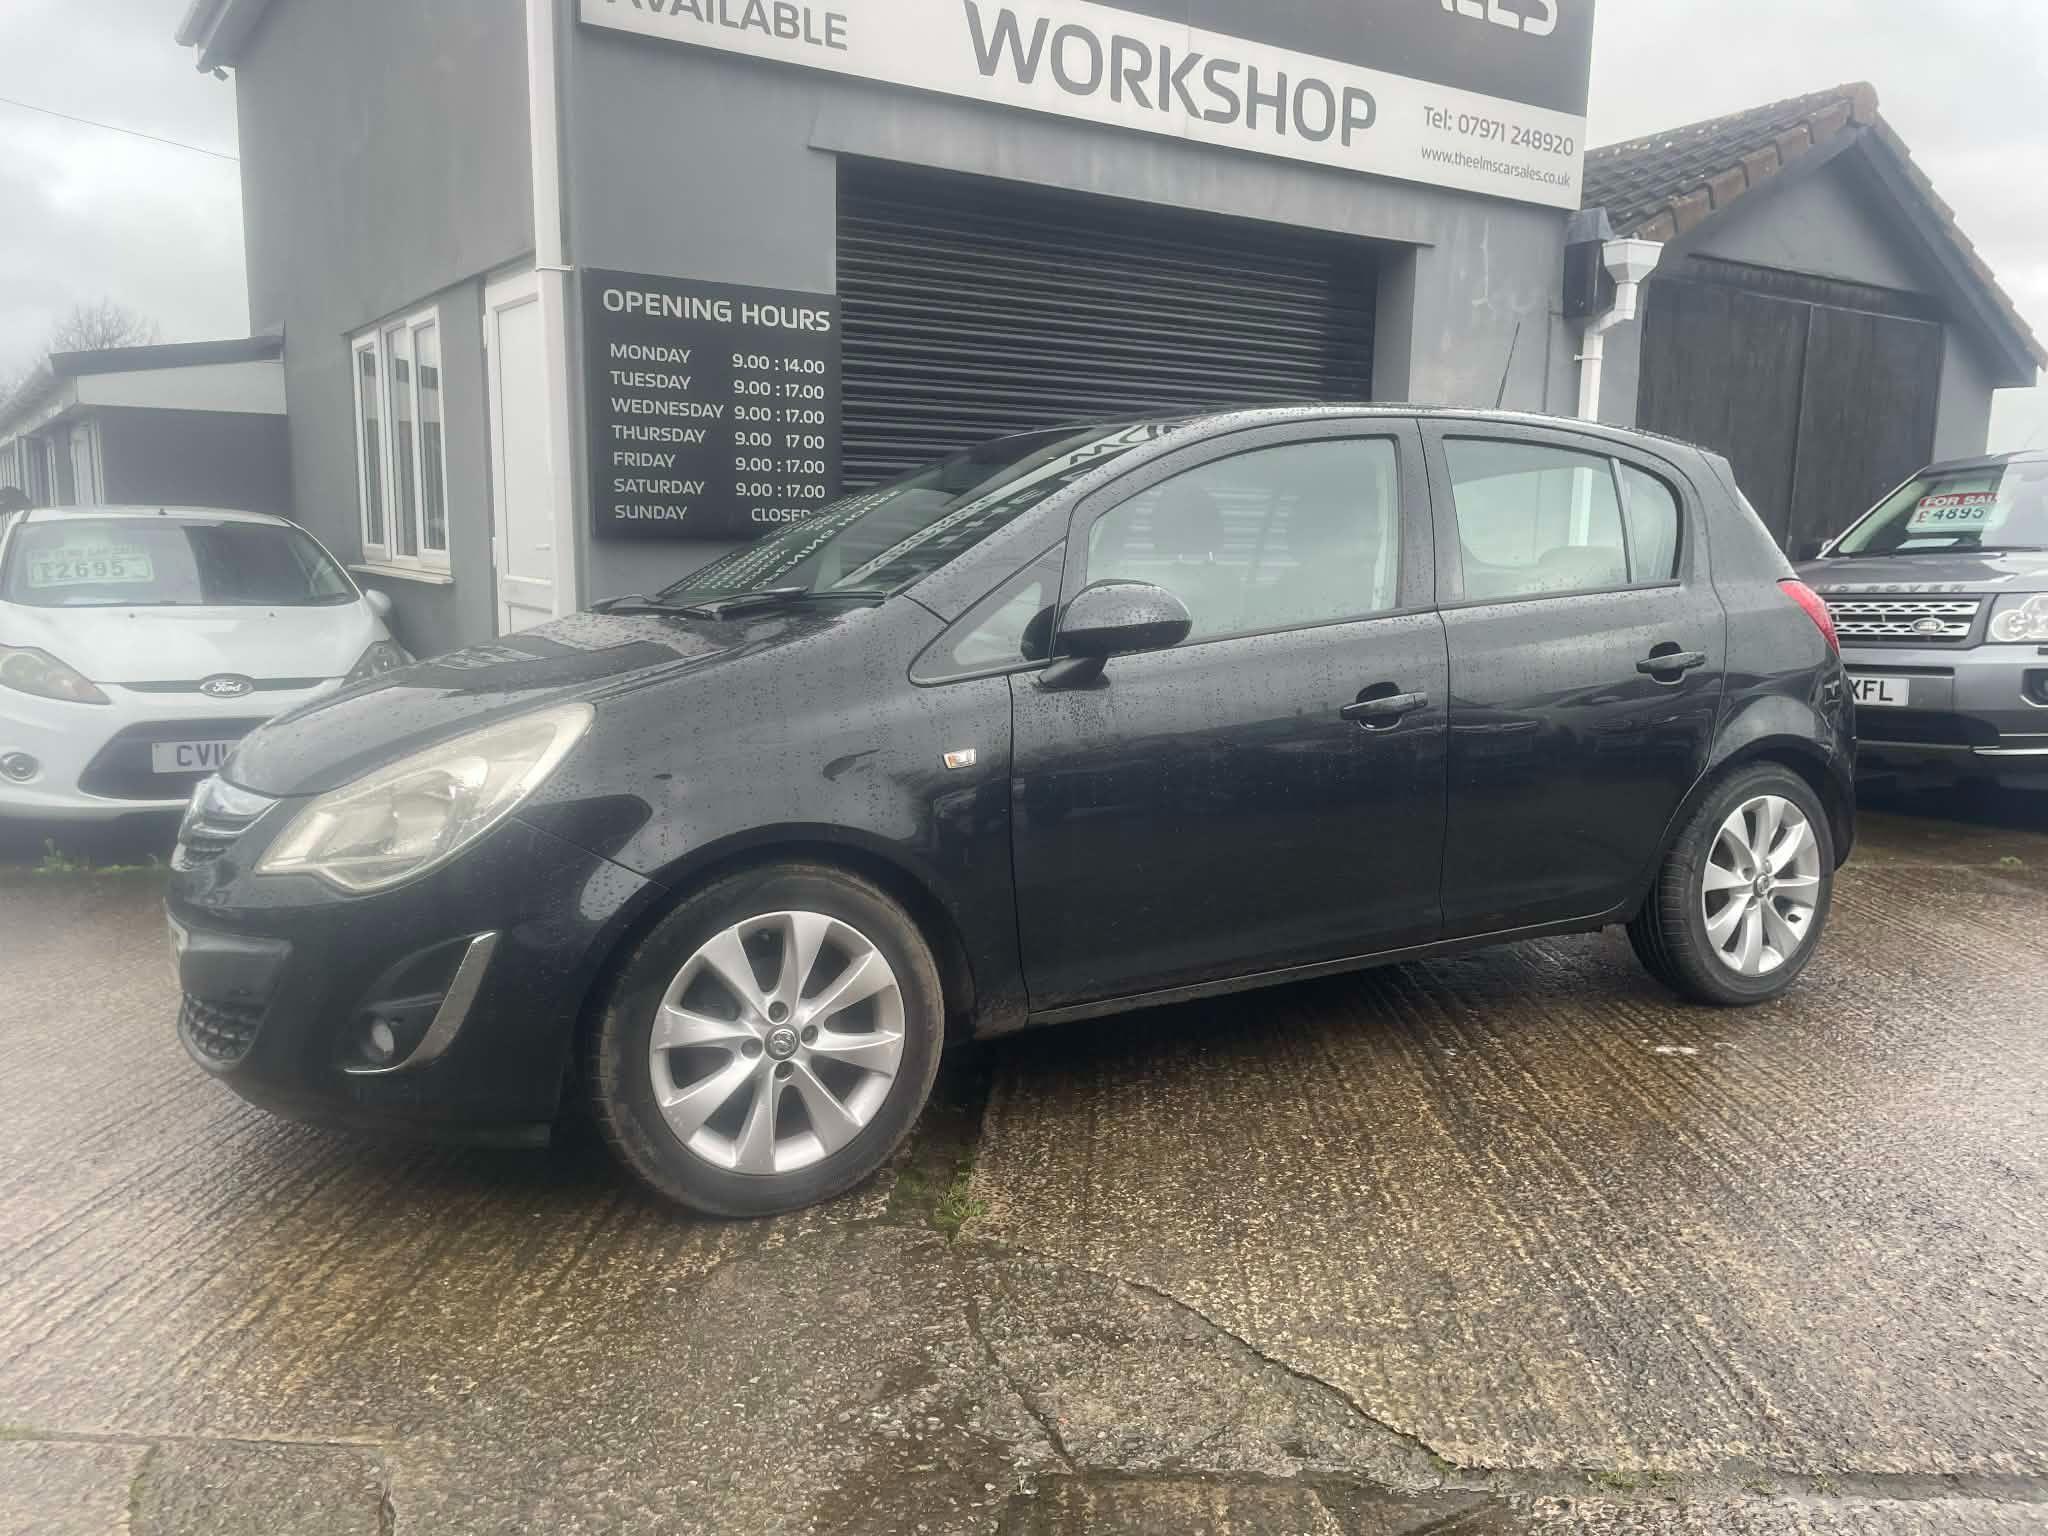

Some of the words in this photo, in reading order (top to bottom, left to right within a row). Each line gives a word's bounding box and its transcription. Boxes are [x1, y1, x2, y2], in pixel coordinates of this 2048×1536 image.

[607, 0, 848, 51] AILABLE
[964, 0, 1378, 148] WORKSHOP
[1423, 105, 1453, 132] Tel:
[1457, 113, 1505, 143] 07971
[1510, 125, 1574, 157] 248920
[1420, 145, 1571, 187] www.theelmscarsales.co.uk
[603, 288, 732, 323] OPENING
[741, 302, 831, 332] HOURS
[610, 343, 692, 364] MONDAY
[732, 353, 770, 371] 9.00
[783, 357, 825, 374] 14.00
[610, 370, 692, 390] TUESDAY
[733, 379, 771, 396] 9.00
[785, 383, 825, 400] 17.00
[611, 397, 725, 419] WEDNESDAY
[734, 405, 772, 421] 9.00
[785, 408, 825, 425] 17.00
[611, 424, 706, 443] THURSDAY
[734, 431, 772, 447] 9.00
[613, 451, 676, 468] FRIDAY
[735, 457, 772, 472] 9.00
[785, 459, 825, 474] 17.00
[613, 478, 705, 495] SATURDAY
[735, 482, 773, 497] 9.00
[786, 484, 826, 499] 17.00
[615, 505, 688, 520] SUNDAY
